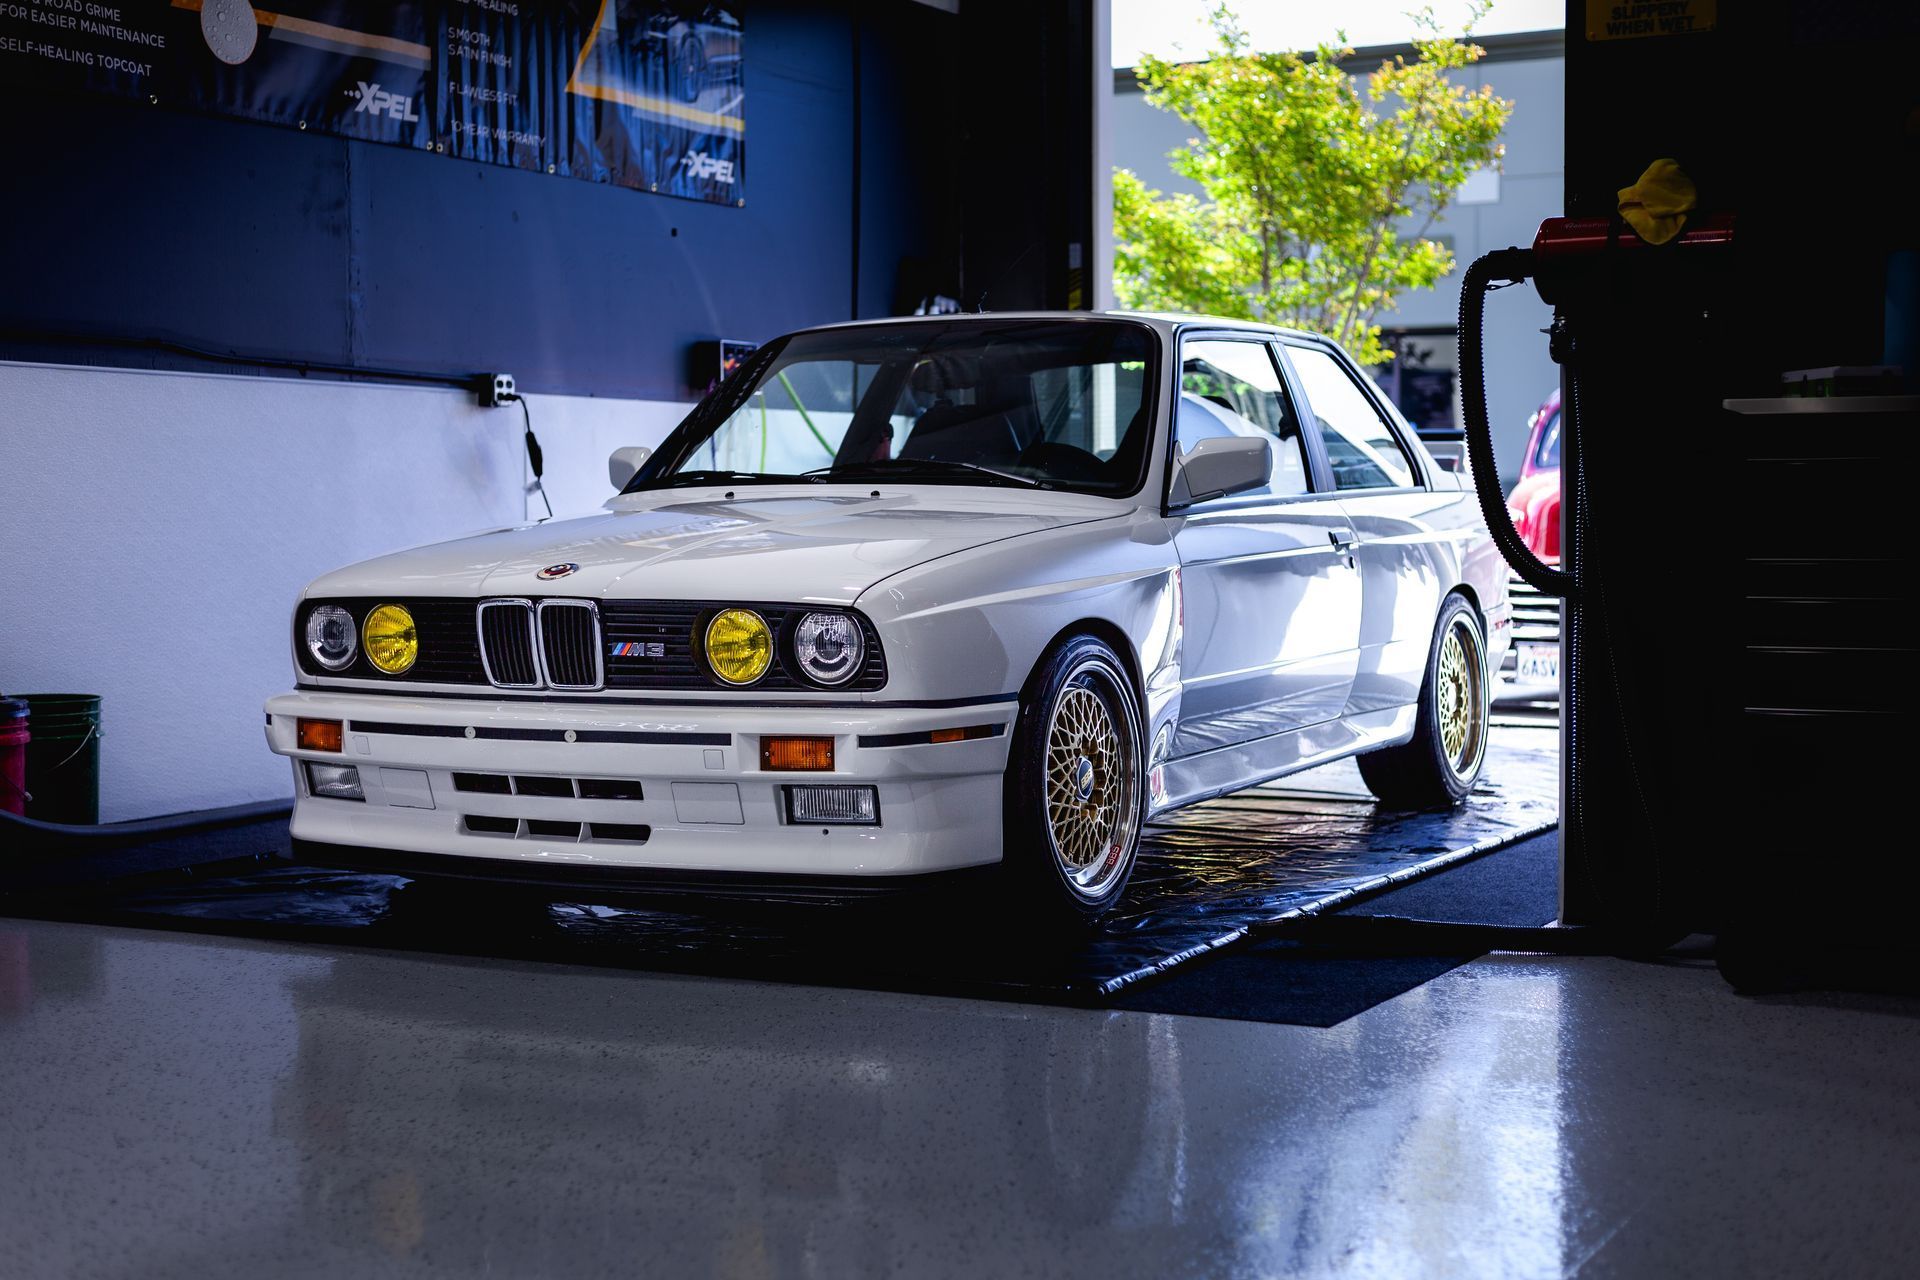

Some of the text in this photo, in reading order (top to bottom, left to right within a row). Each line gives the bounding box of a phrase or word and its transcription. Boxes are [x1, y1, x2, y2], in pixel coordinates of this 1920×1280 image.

[85, 3, 121, 22] GRIME
[1611, 1, 1689, 20] SLIPPERY
[0, 3, 166, 48] FOR EASIER MAINTENANCE
[1606, 15, 1695, 35] WHEN WET
[447, 26, 490, 47] SMOOTH
[0, 36, 152, 77] SELF-HEALING TOPCOAT
[447, 43, 512, 68] SATIN FINISH
[354, 81, 419, 123] XPEL
[449, 81, 518, 107] FLAWLESS FIT
[491, 128, 546, 148] WARRANTY
[687, 150, 735, 184] XPEL
[626, 642, 665, 657] M3
[1105, 846, 1120, 865] BBS
